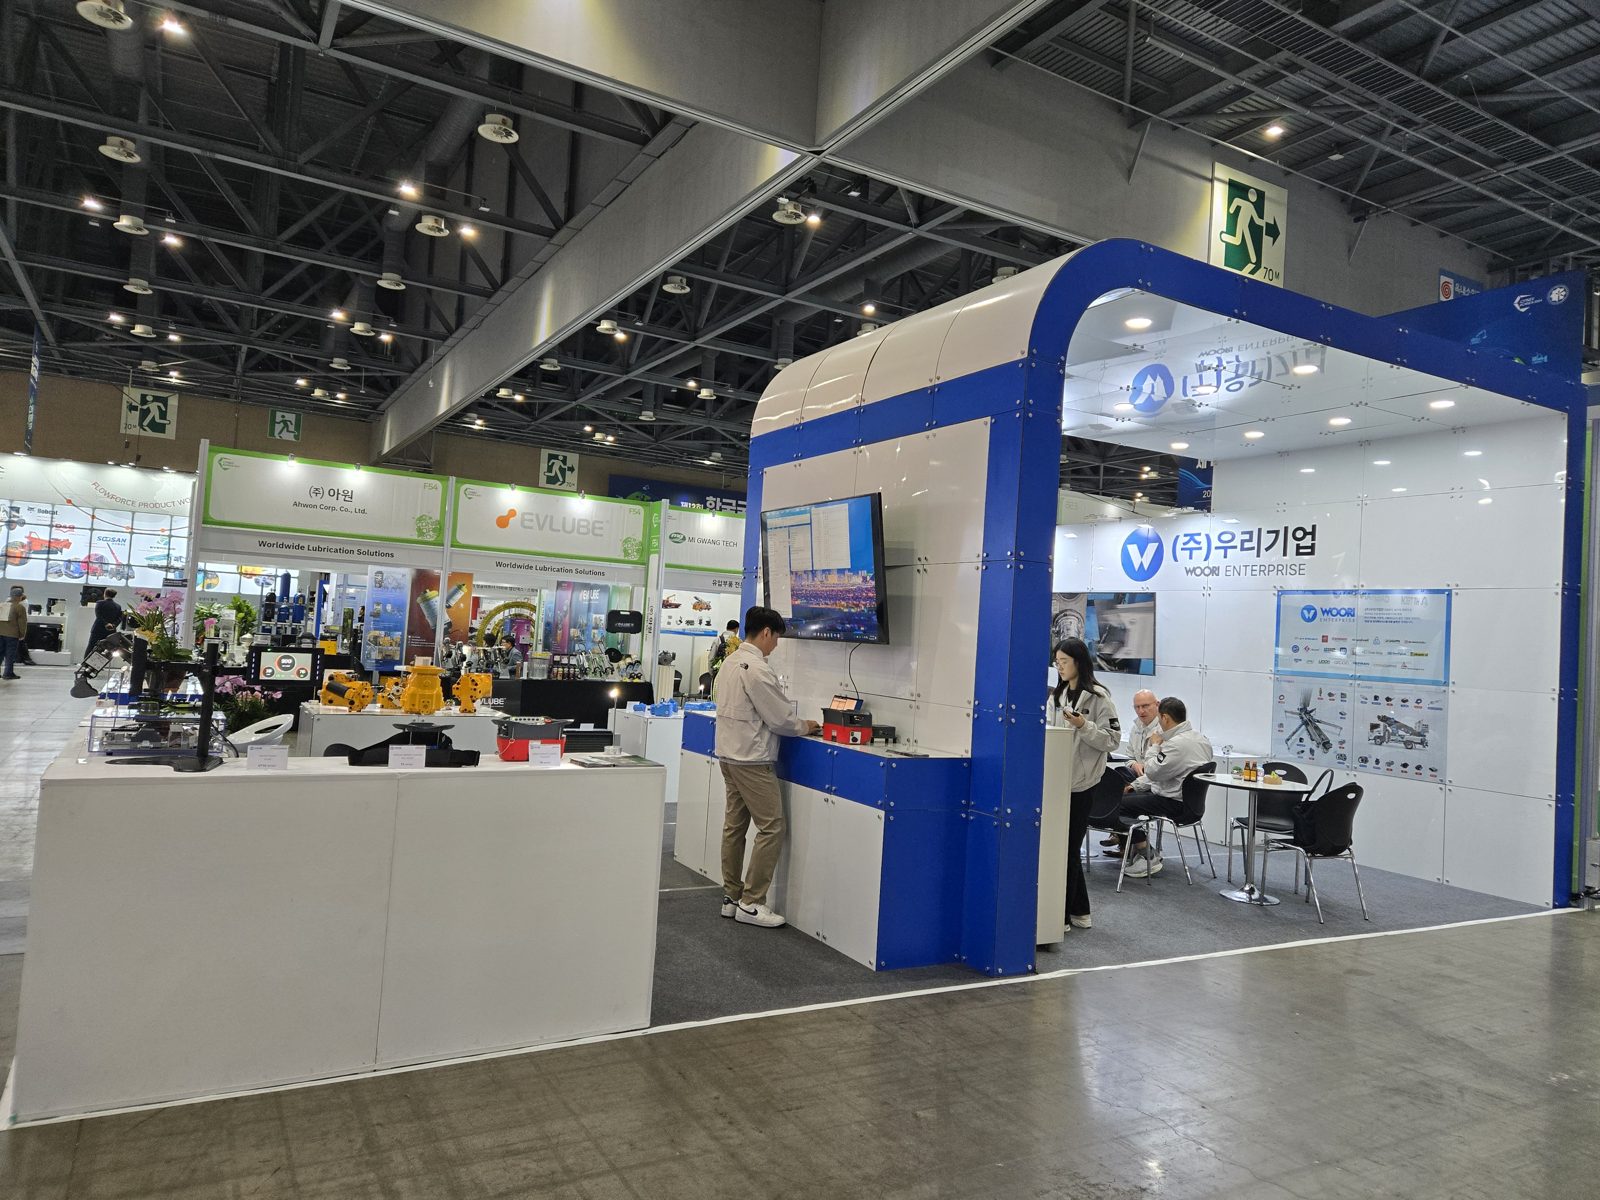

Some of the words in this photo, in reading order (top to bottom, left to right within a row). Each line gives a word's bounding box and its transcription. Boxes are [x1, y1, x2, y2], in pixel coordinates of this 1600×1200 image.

[91, 481, 137, 508] FLOWFORCE
[328, 487, 354, 503] 아원
[292, 501, 318, 510] Ahwon
[319, 504, 338, 513] Corp.
[339, 506, 353, 514] Co.,
[354, 507, 368, 515] Ltd.
[520, 512, 604, 538] EVLUBE
[258, 540, 305, 552] Worldwide
[307, 544, 354, 556] Lubrication
[356, 548, 395, 559] Solutions
[697, 537, 721, 546] GWANG
[722, 540, 738, 548] TECH
[1171, 524, 1318, 563] (주)우리기업
[495, 560, 533, 571] Worldwide
[535, 564, 573, 575] Lubrication
[574, 567, 606, 577] Solutions
[1184, 565, 1221, 578] WOORI
[1225, 562, 1307, 578] ENTERPRISE
[1320, 606, 1356, 618] WOORI
